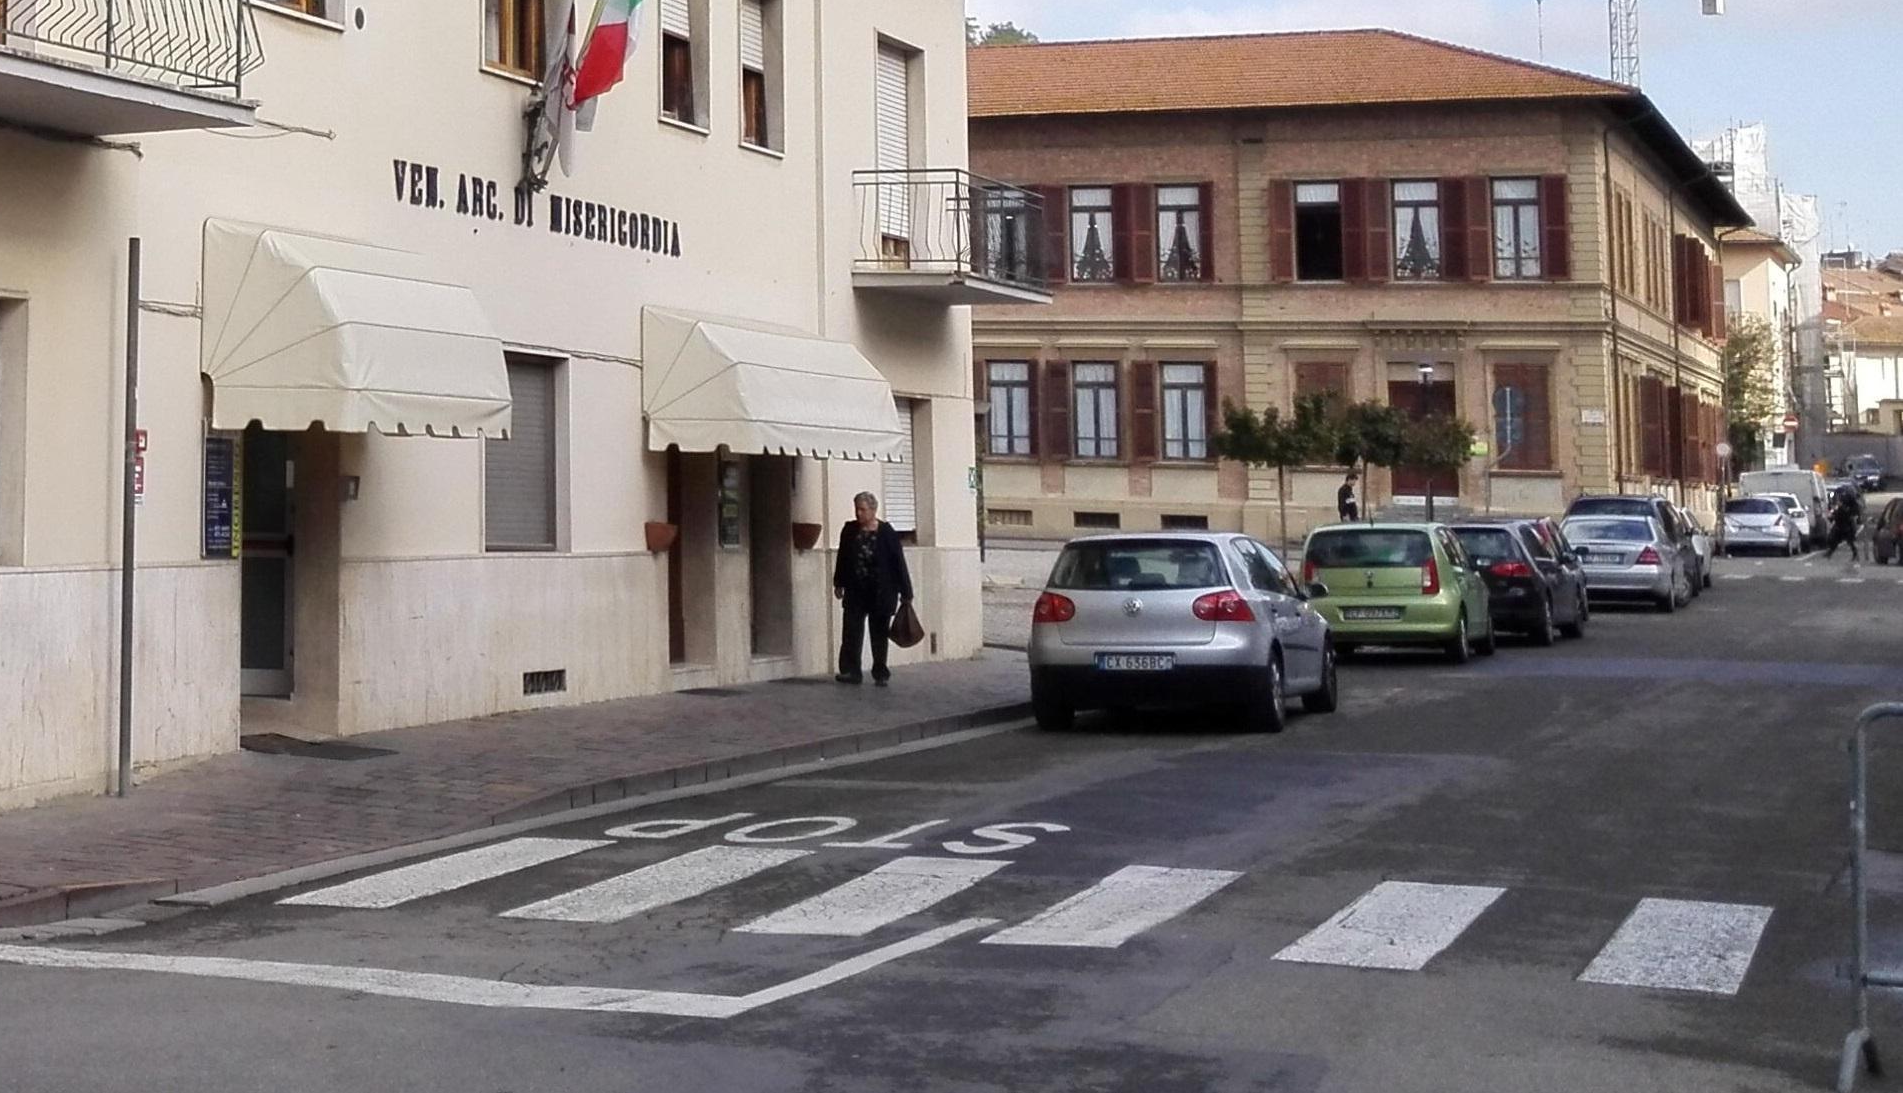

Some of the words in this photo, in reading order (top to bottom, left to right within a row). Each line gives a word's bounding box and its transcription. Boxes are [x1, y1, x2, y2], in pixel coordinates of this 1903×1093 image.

[393, 159, 445, 209] VEN.
[456, 173, 504, 222] ARC.
[513, 185, 533, 227] DI
[549, 194, 682, 257] MISERICORDIA
[603, 812, 1071, 854] STOP
